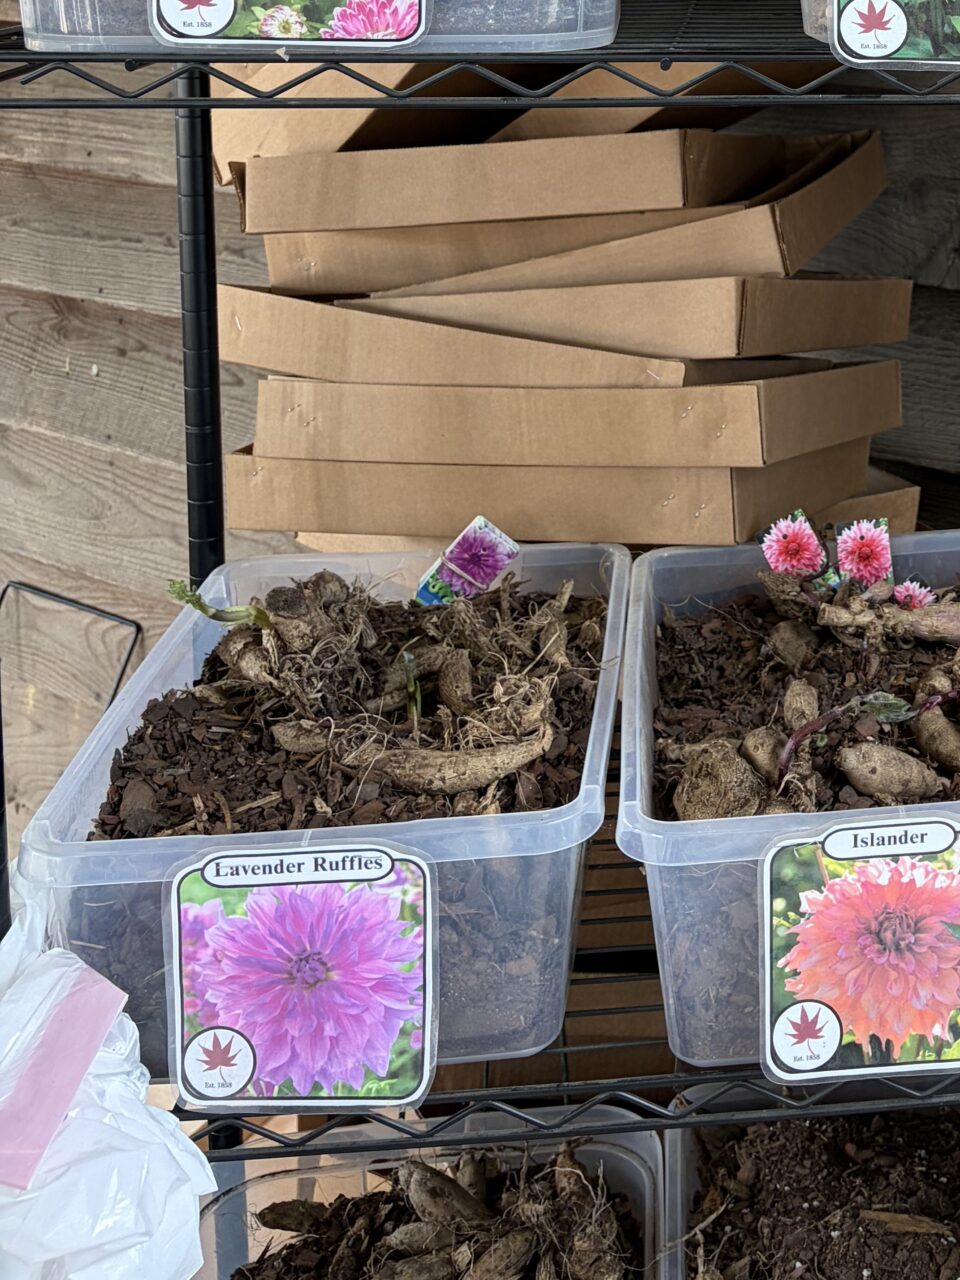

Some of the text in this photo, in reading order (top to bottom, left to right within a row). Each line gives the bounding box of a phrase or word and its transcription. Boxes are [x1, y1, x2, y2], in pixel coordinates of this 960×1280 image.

[852, 830, 928, 849] Islander
[214, 855, 383, 878] Lavender Ruffles
